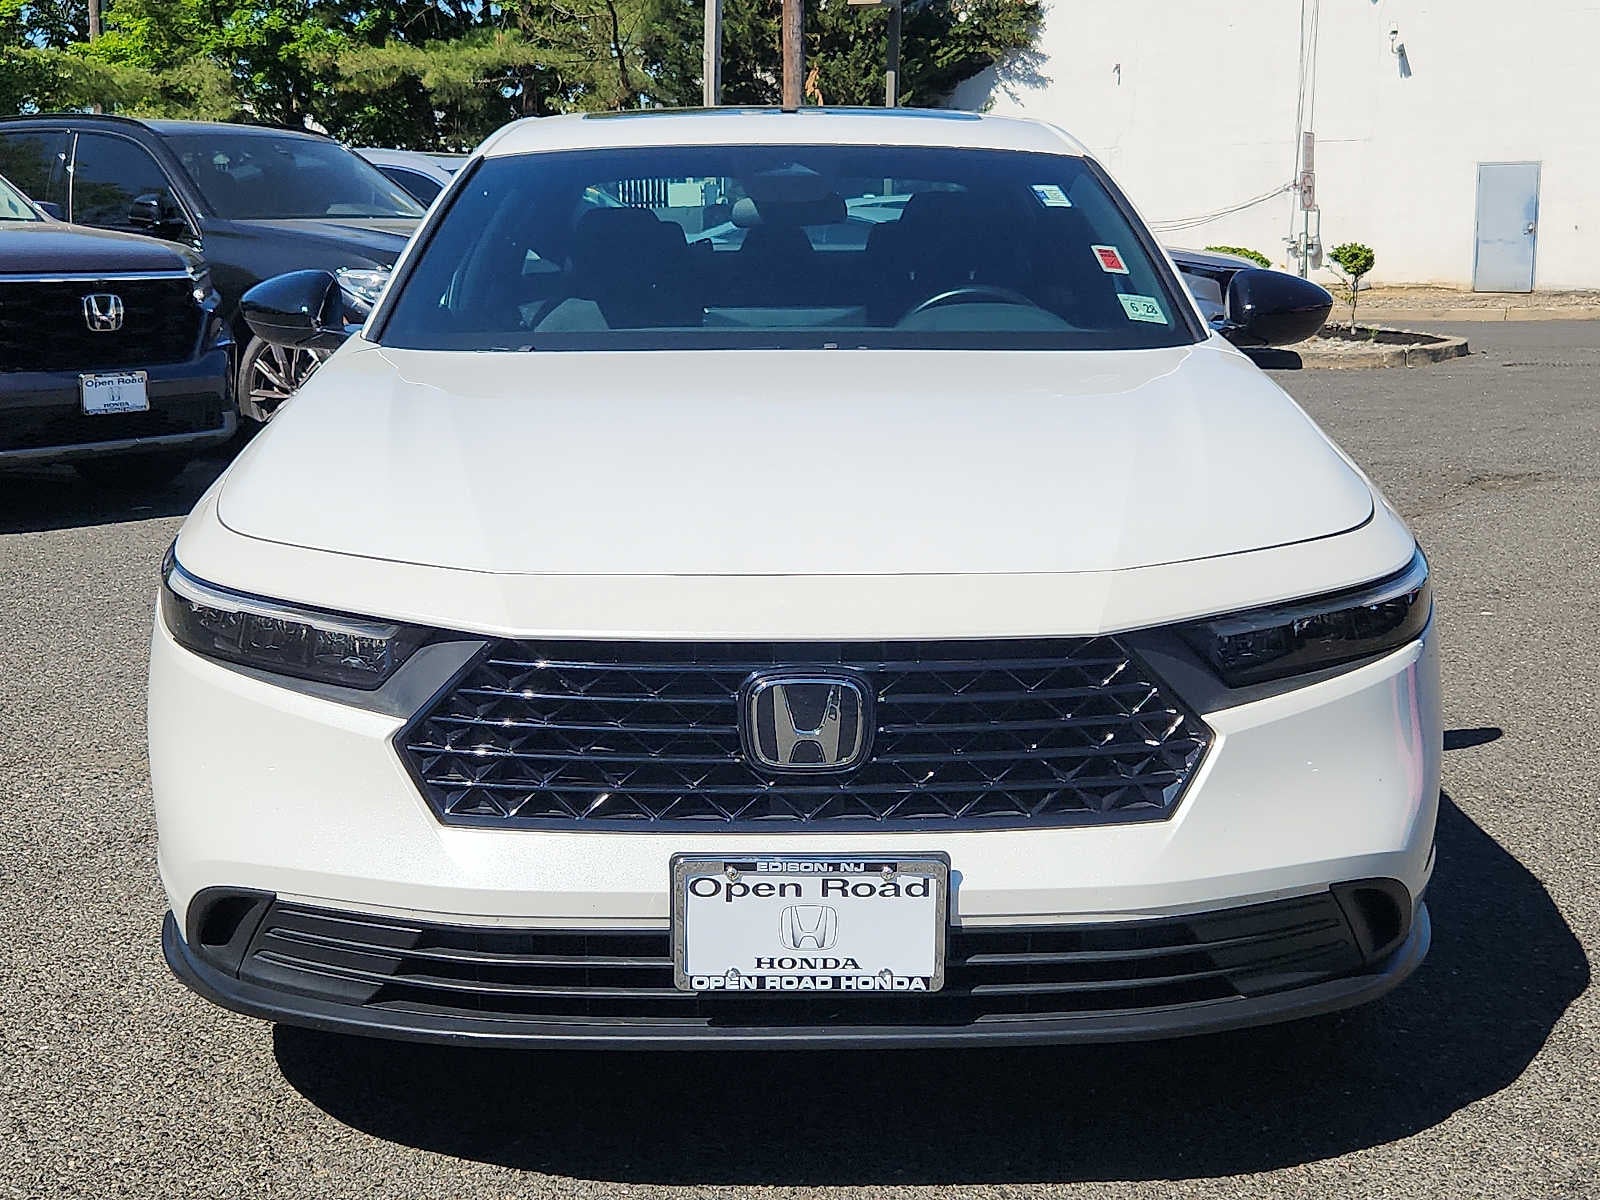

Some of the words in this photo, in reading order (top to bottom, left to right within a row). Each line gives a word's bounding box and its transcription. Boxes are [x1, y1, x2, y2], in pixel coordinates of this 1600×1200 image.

[1130, 302, 1139, 312] 6
[85, 379, 114, 388] Open
[117, 377, 144, 385] Road
[839, 861, 865, 872] NJ
[689, 876, 803, 902] Open
[821, 877, 930, 898] Road
[754, 957, 863, 970] HONDA
[691, 976, 757, 990] OPEN
[765, 976, 836, 990] ROAD
[841, 976, 927, 990] HONDA
